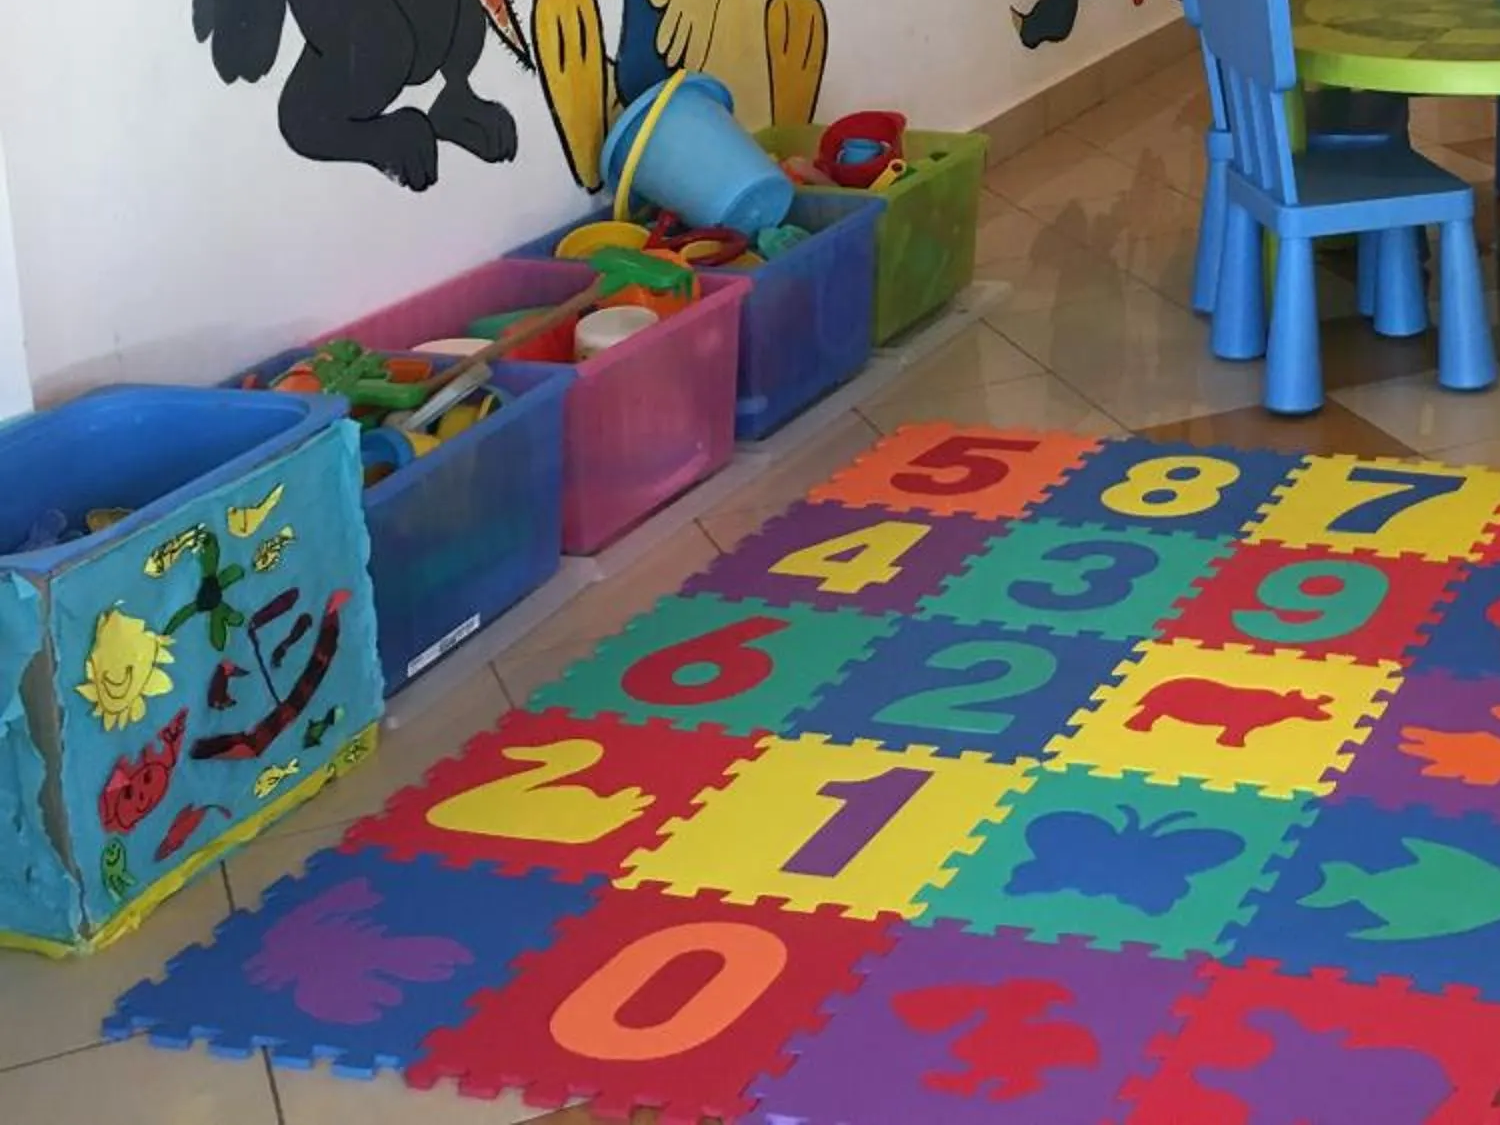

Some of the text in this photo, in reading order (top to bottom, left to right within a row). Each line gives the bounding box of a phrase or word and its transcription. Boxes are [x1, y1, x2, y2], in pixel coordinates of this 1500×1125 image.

[890, 436, 1041, 496] 5
[1101, 456, 1240, 517] 8
[1338, 467, 1467, 533] 7
[769, 522, 930, 593] 4
[1008, 540, 1160, 612] 3
[1232, 560, 1389, 644] 9
[621, 616, 788, 707] 6
[874, 641, 1056, 734] 2
[781, 767, 933, 877] 1
[550, 922, 787, 1060] 0
